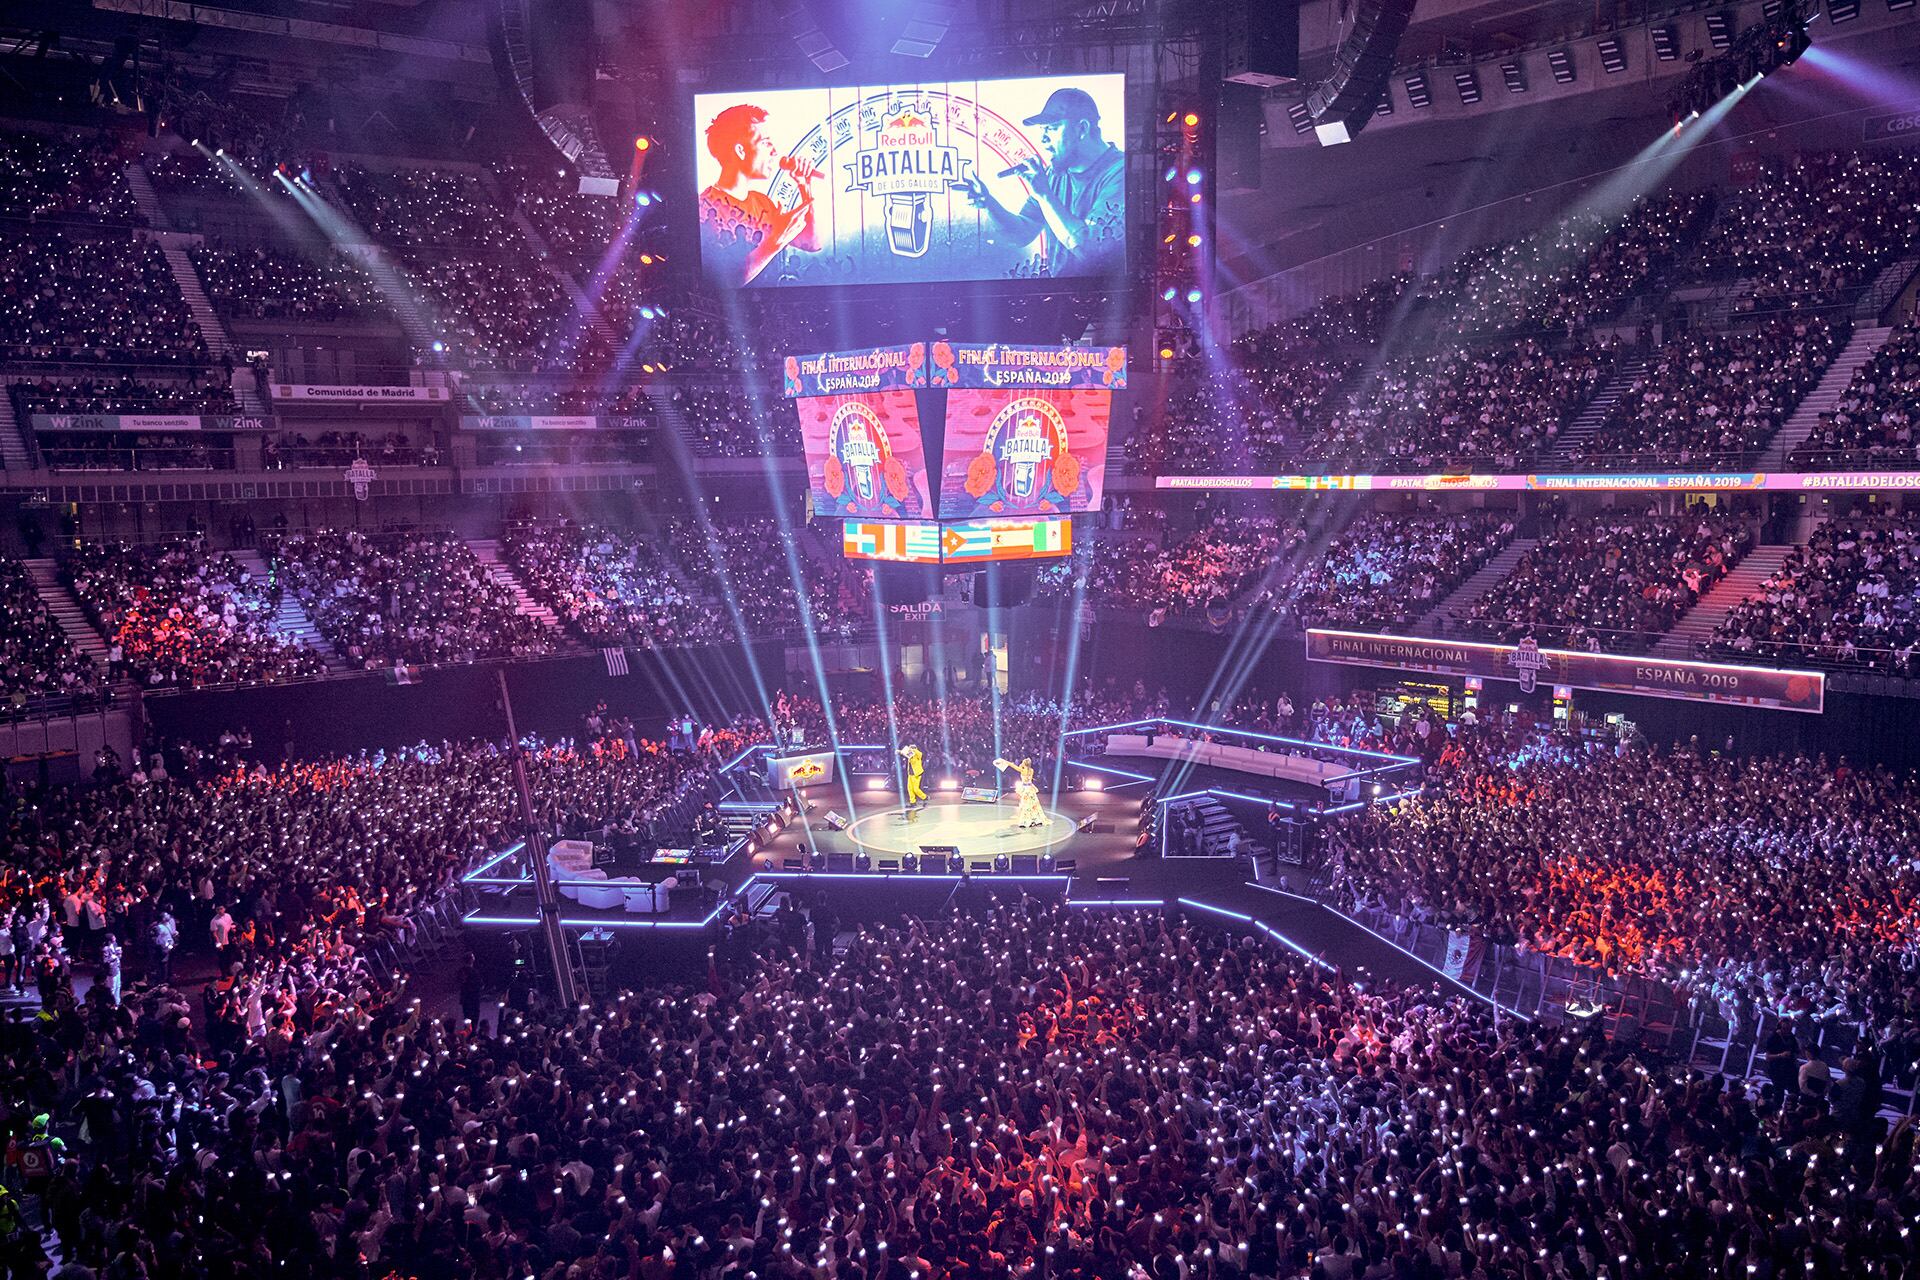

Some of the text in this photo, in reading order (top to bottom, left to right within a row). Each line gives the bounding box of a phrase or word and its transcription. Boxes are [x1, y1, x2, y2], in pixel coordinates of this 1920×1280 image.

[881, 132, 933, 146] Red Bull
[861, 150, 953, 179] BATALLA
[877, 179, 938, 191] DE LOS GALLOS
[801, 352, 906, 375] FINAL INTERNACIONAL
[958, 350, 1103, 366] FINAL INTERNACIONAL
[826, 375, 881, 389] ESPAÑA 2019
[996, 369, 1071, 384] ESPAÑA 2019
[307, 387, 415, 397] Comunidad de Madrid
[50, 416, 103, 428] WiZink
[216, 416, 263, 428] WiZink
[477, 417, 519, 428] WiZink
[608, 417, 647, 427] WiZink
[845, 443, 876, 457] BATALLA
[1006, 439, 1047, 454] BATALLA
[1170, 478, 1253, 487] #BATALLADELOSGALLOS
[1390, 478, 1499, 488] #BATALDELOSGALOS
[1546, 475, 1742, 488] FINAL INTERNACIONAL ESPAÑA 2019
[889, 602, 942, 613] SALIDA
[904, 613, 928, 621] EXIT
[1332, 640, 1471, 663] FINAL INTERNACIONAL
[1511, 652, 1545, 664] BATALLA
[1636, 667, 1739, 688] ESPAÑA 2019
